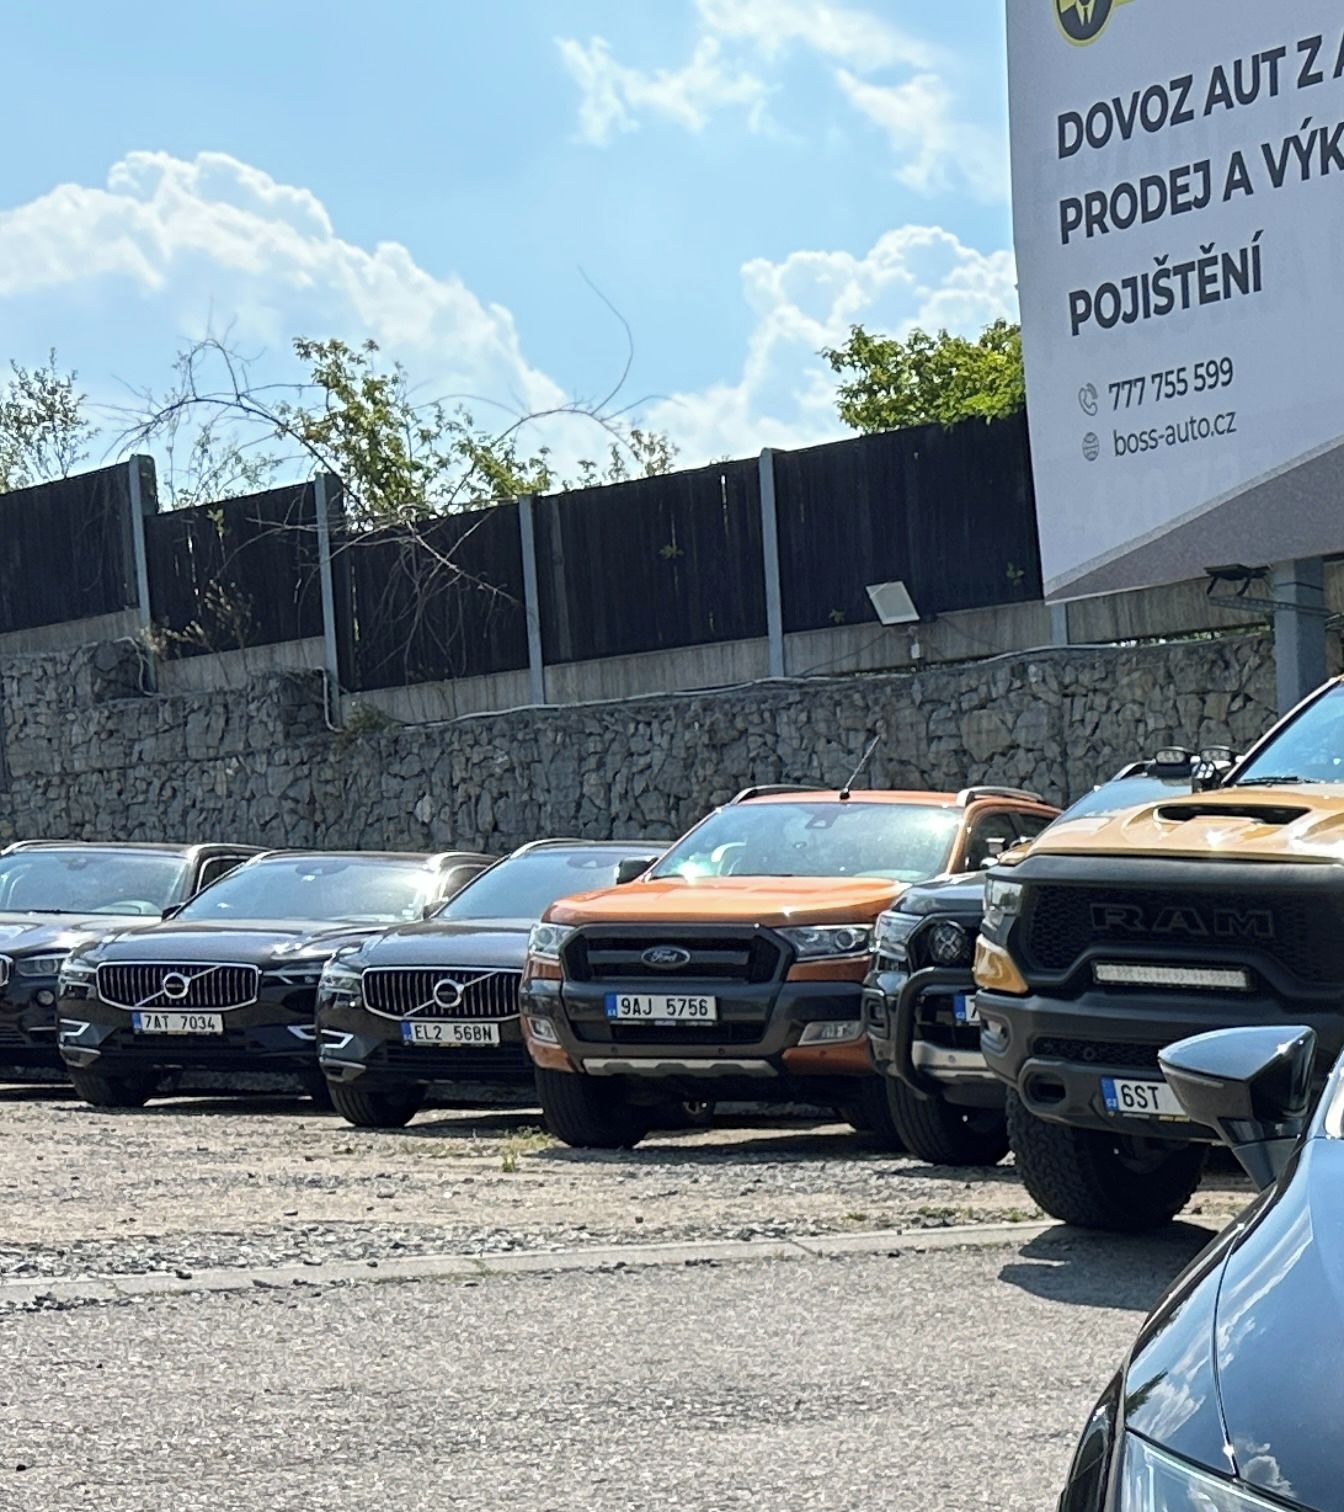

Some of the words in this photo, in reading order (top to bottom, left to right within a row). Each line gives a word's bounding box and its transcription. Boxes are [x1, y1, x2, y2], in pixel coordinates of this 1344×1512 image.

[1057, 74, 1195, 160] DOVOZ
[1203, 46, 1287, 118] AUT
[1296, 34, 1324, 89] Z
[1060, 159, 1212, 246] PRODEJ
[1222, 151, 1254, 203] A
[1068, 229, 1265, 337] POJIŠTĚNÍ
[1108, 376, 1146, 412] 777
[1151, 366, 1189, 402] 755
[1193, 356, 1234, 393] 599
[1112, 411, 1238, 458] boss-auto.cz
[1089, 902, 1275, 938] RAM
[144, 1014, 170, 1029] 7AT
[180, 1015, 215, 1030] 7034
[620, 997, 653, 1016] 9AJ
[665, 998, 709, 1017] 5756
[414, 1024, 443, 1041] EL2
[1120, 1083, 1160, 1110] 6ST
